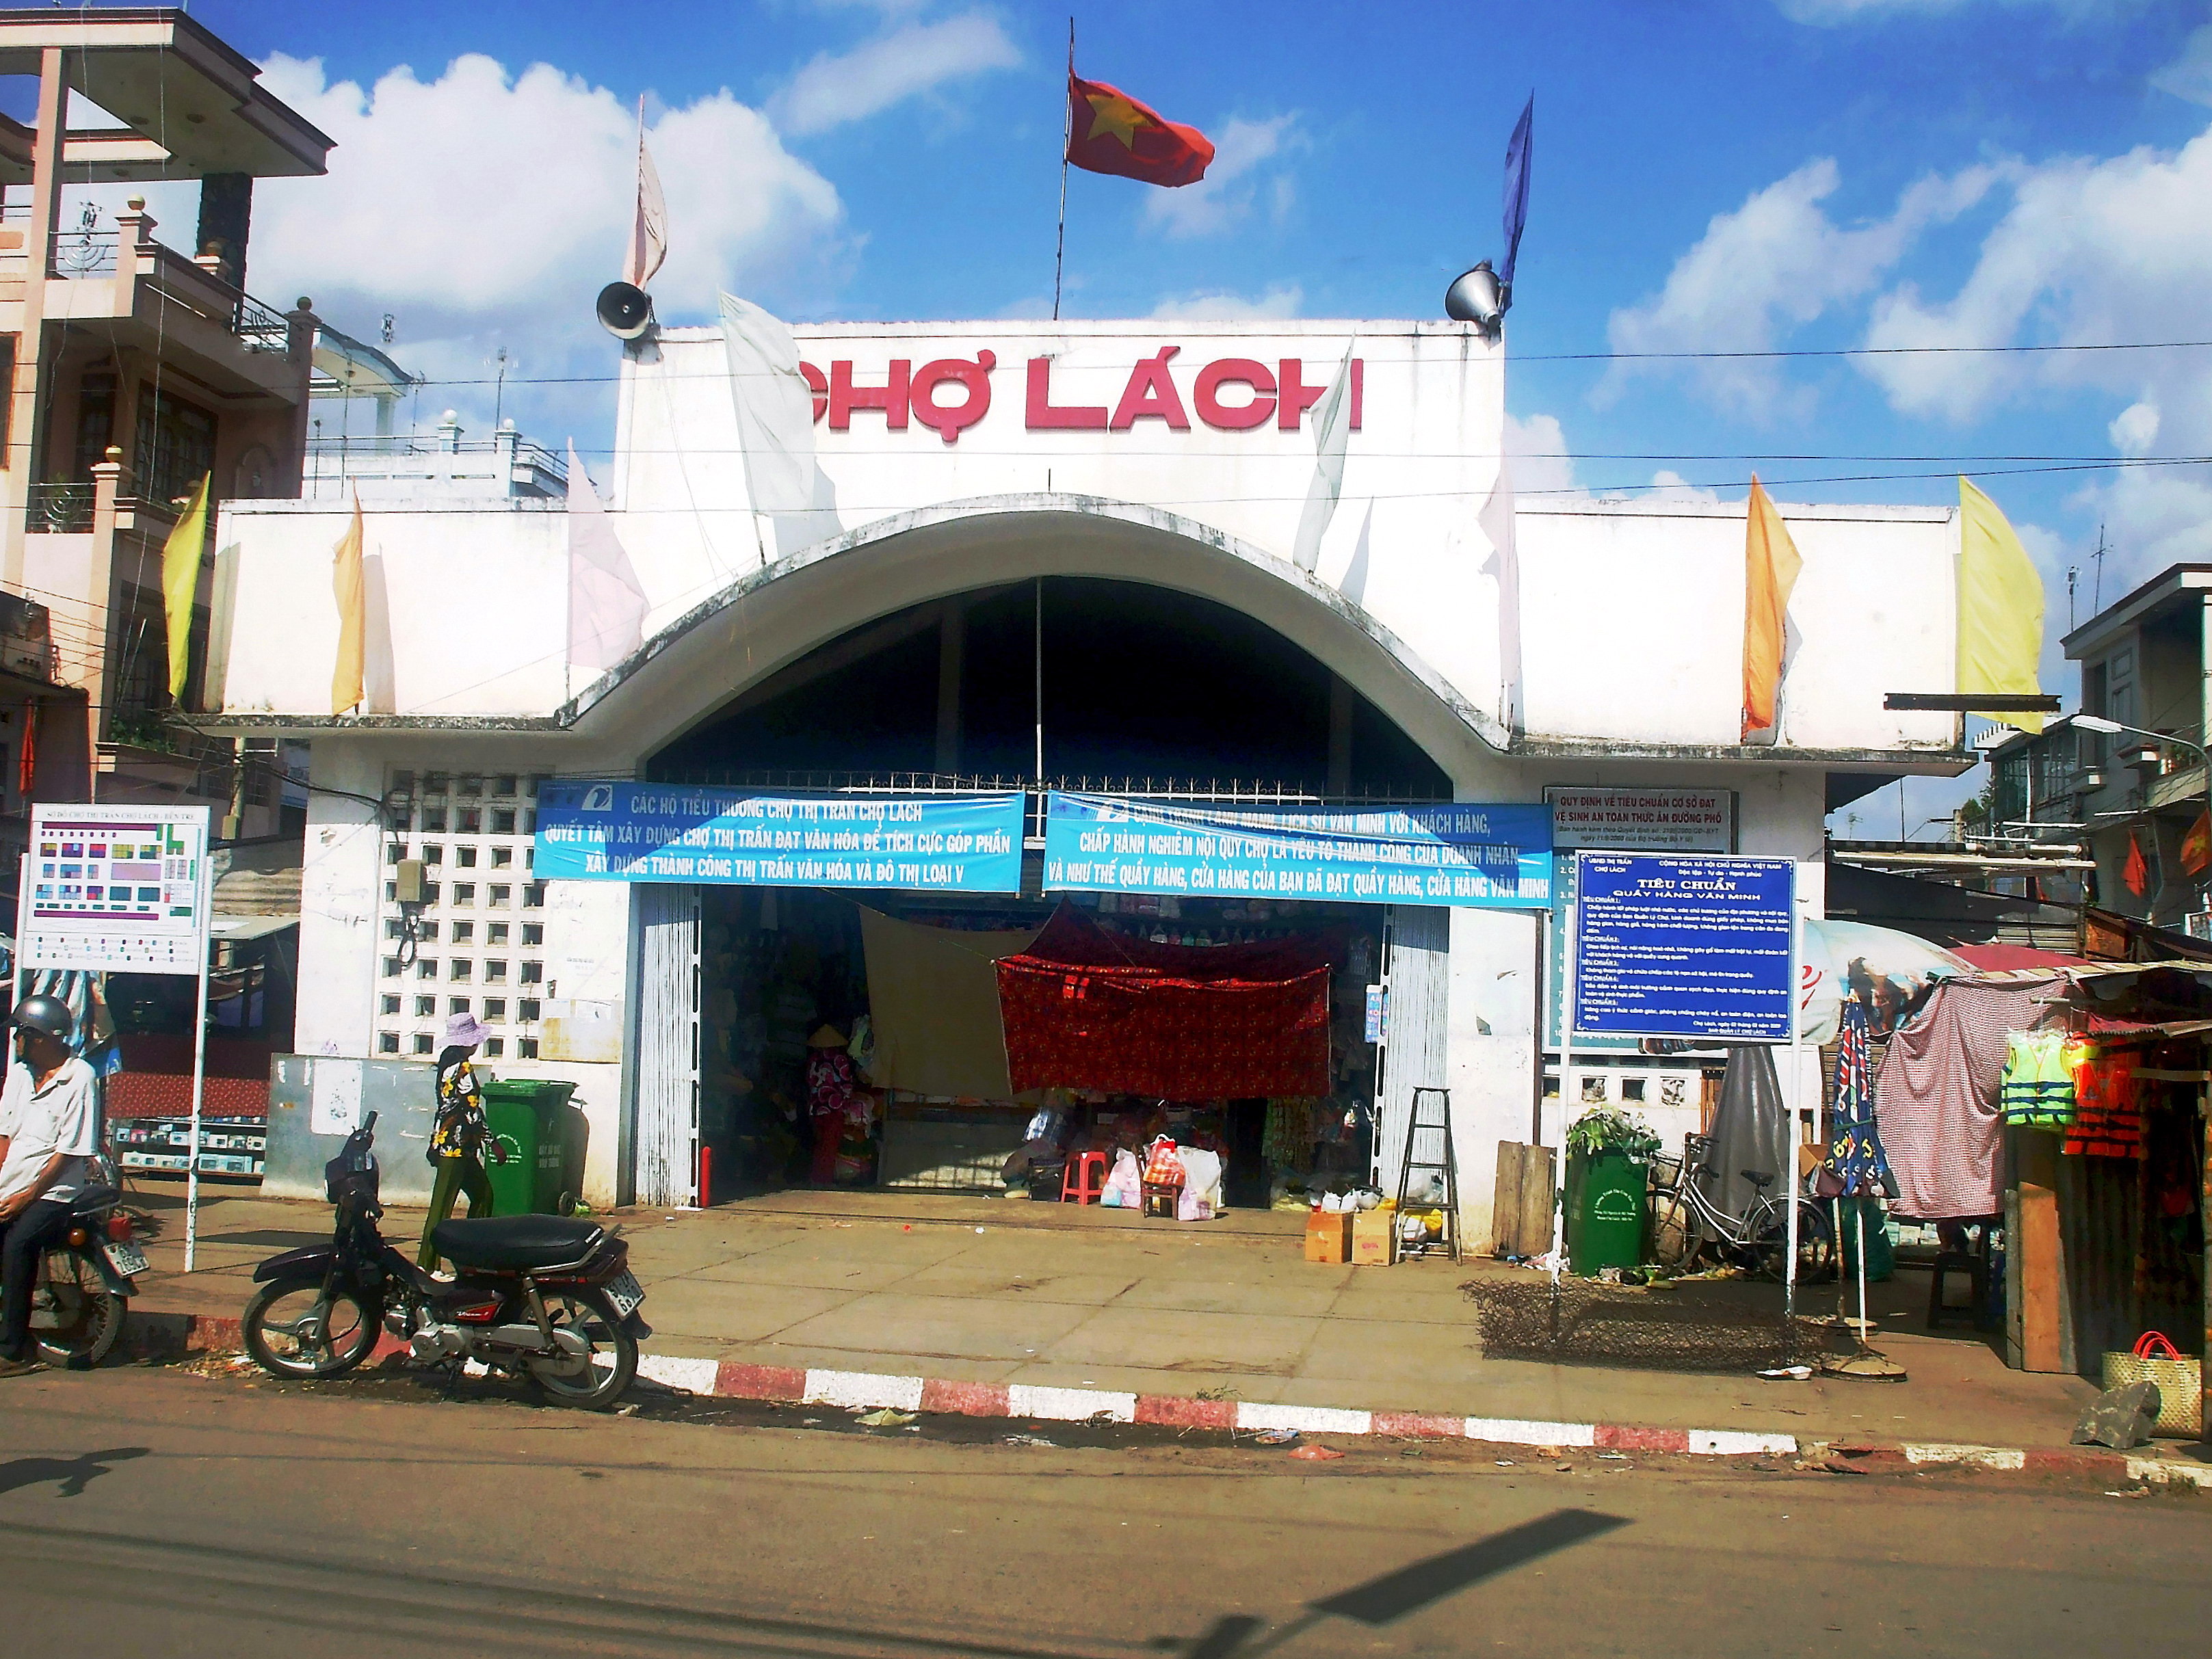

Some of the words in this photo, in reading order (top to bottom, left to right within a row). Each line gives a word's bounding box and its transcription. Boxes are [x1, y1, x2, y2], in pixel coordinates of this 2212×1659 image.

[1025, 346, 1364, 431] LÁCH
[631, 792, 656, 814] CÁC
[660, 793, 676, 819] HỘ
[682, 788, 710, 816] TIỂU
[1555, 809, 1566, 824] VỆ
[1568, 812, 1590, 822] SINH
[1592, 812, 1604, 822] AN
[1605, 810, 1629, 822] TOÀN
[1560, 796, 1579, 806] QUY
[1581, 796, 1601, 809] ĐỊNH
[1618, 795, 1637, 807] TIÊU
[1639, 793, 1669, 808] CHUẨN
[1672, 795, 1684, 808] CƠ
[1699, 798, 1715, 811] ĐẠT
[544, 817, 584, 845] QUYẾT
[588, 820, 614, 843] TÂM
[618, 821, 642, 844] XÂY
[646, 824, 680, 847] DỰNG
[683, 825, 710, 850] CHỢ
[713, 829, 734, 851] THỊ
[738, 823, 772, 849] TRẤN
[775, 831, 801, 852] ĐẠT
[804, 828, 830, 850] VĂN
[833, 827, 859, 851] HÓA
[885, 829, 914, 852] TÍCH
[917, 831, 943, 855] CỰC
[947, 828, 971, 852] GÓP
[976, 827, 1010, 853] PHẦN
[1356, 814, 1386, 834] MINH
[1412, 808, 1451, 834] KHÁCH
[1079, 825, 1109, 853] CHẤP
[1114, 828, 1145, 854] HÀNH
[1148, 830, 1193, 856] NGHIÊM
[1219, 836, 1241, 861] QUY
[1442, 845, 1482, 866] DOANH
[1486, 841, 1518, 866] NHÂN
[585, 850, 610, 873] XÂY
[651, 852, 693, 875] THÀNH
[697, 854, 731, 877] CÔNG
[735, 860, 756, 882] THỊ
[760, 854, 793, 879] TRẤN
[798, 858, 821, 880] VĂN
[826, 858, 852, 881] HÓA
[856, 858, 872, 881] VÀ
[876, 859, 894, 882] ĐÔ
[898, 862, 919, 887] THỊ
[923, 864, 951, 886] LOẠI
[956, 864, 964, 883] V
[1049, 857, 1062, 882] VÀ
[1066, 860, 1092, 883] NHƯ
[1094, 857, 1118, 884] THẾ
[1153, 862, 1188, 891] HÀNG,
[1191, 860, 1215, 888] CỬA
[1218, 864, 1249, 889] HÀNG
[1278, 871, 1303, 897] BẠN
[1306, 867, 1322, 892] ĐÃ
[1326, 872, 1349, 897] ĐẠT
[1388, 868, 1423, 899] HÀNG,
[1427, 868, 1452, 897] CỬA
[1454, 871, 1488, 898] HÀNG
[1490, 874, 1515, 899] VĂN
[1518, 877, 1549, 899] MINH
[1637, 877, 1676, 889] TIÊU
[1681, 877, 1736, 891] CHUẨN
